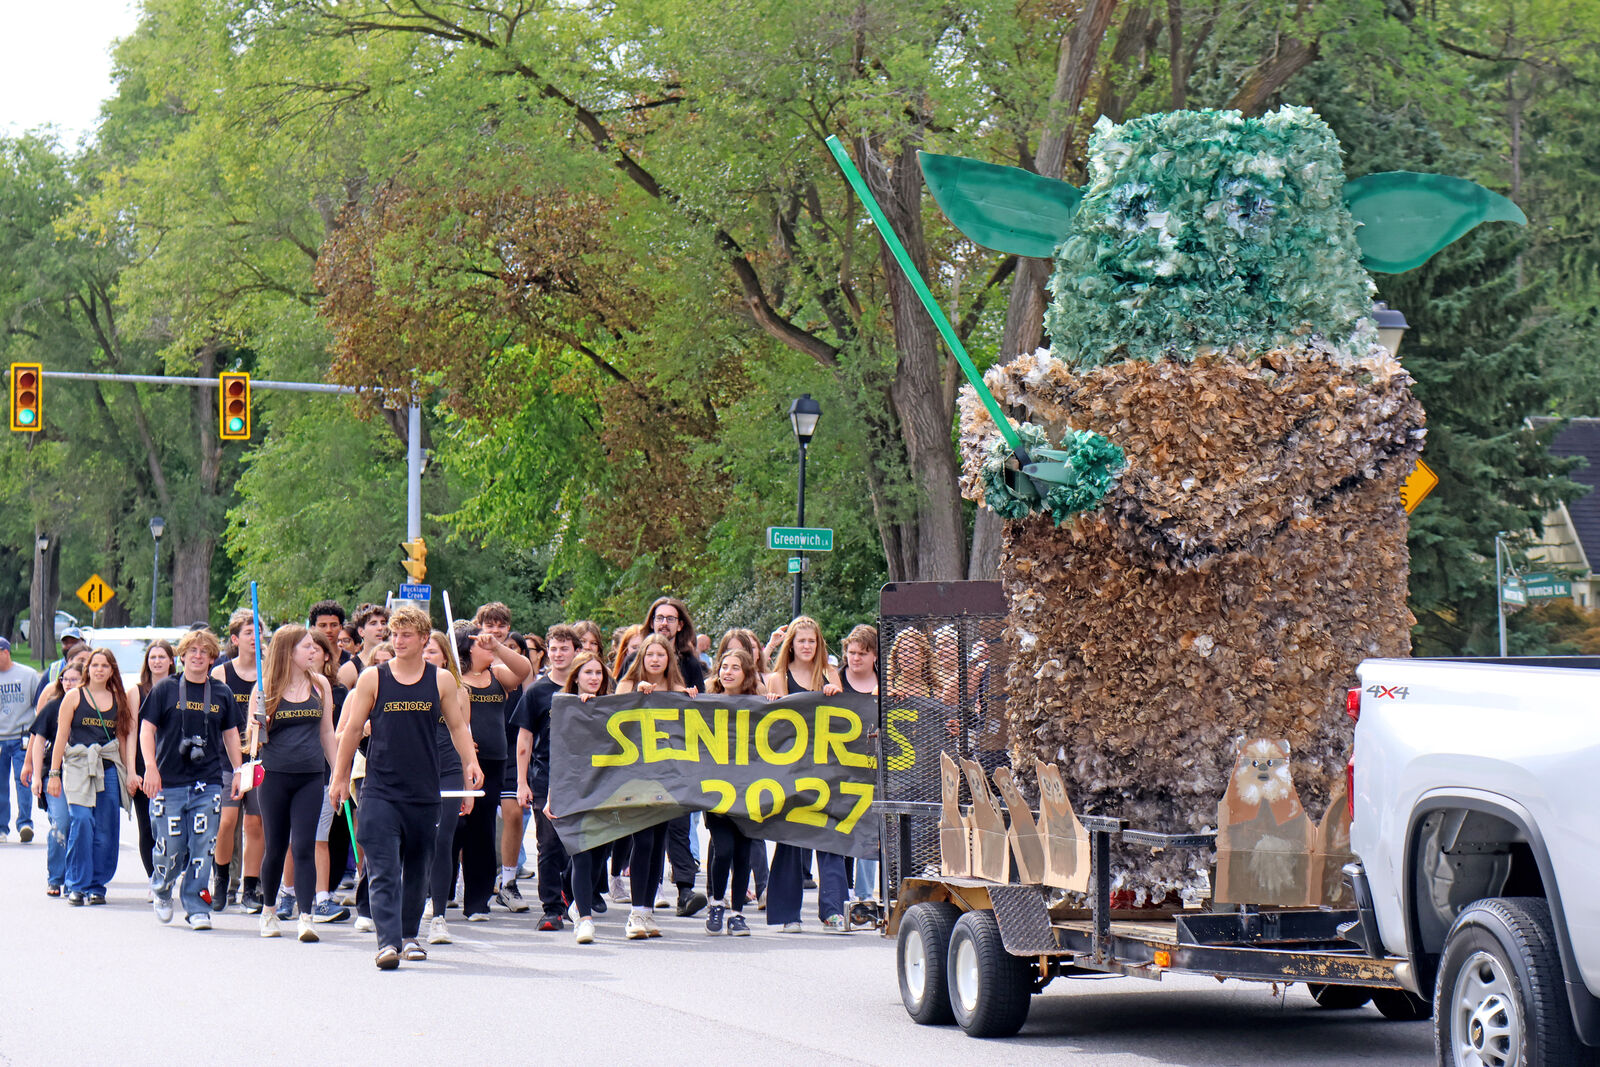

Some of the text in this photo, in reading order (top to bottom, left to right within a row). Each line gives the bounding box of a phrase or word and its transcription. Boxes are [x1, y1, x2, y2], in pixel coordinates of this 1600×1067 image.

[774, 531, 821, 546] Greenwich
[0, 682, 21, 693] RUIN
[384, 701, 432, 712] SENIORS
[700, 777, 875, 835] 2027
